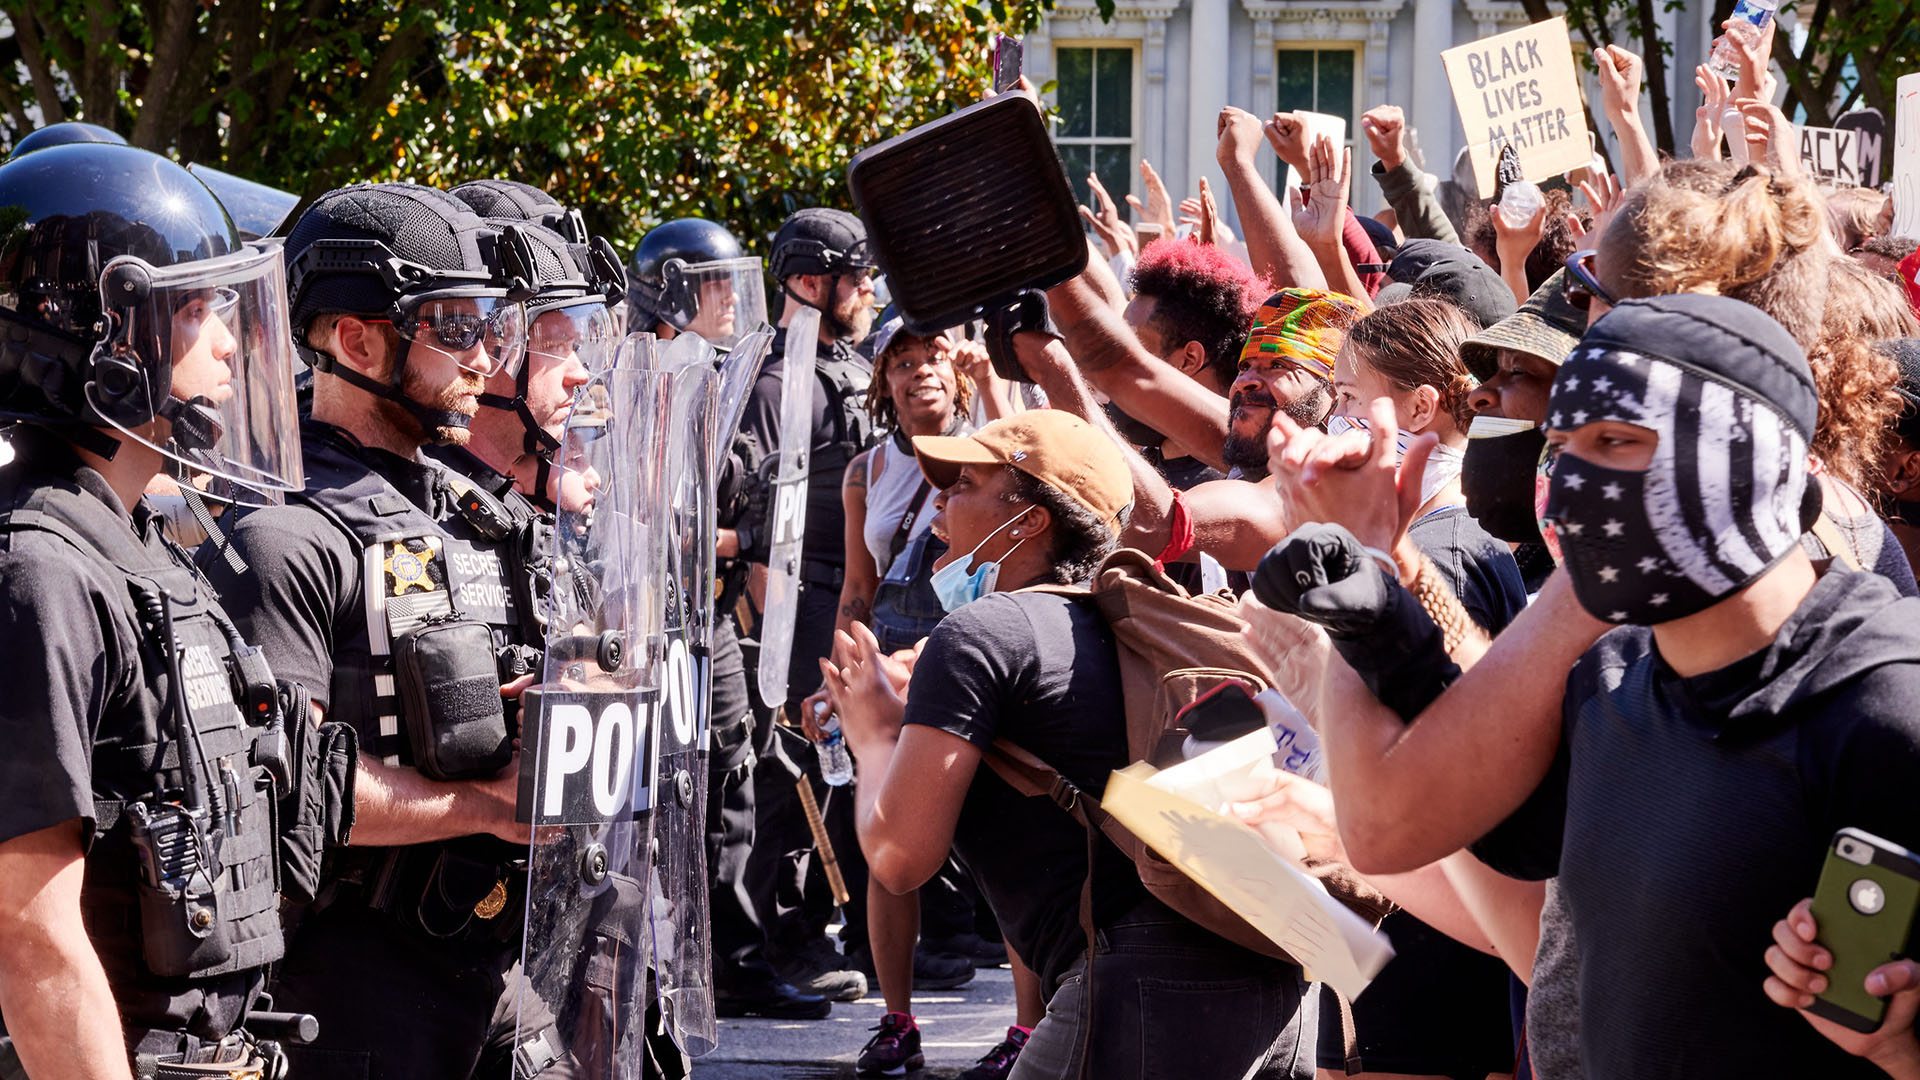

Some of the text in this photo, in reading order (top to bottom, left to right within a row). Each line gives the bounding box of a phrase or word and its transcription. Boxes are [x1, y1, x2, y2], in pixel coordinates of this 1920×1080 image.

[1467, 38, 1543, 89] BLACK
[1482, 79, 1543, 119] LIVES
[1487, 107, 1570, 158] MATTER
[1801, 129, 1855, 181] ACK
[453, 552, 504, 577] SECRET
[460, 582, 514, 608] SERVICE
